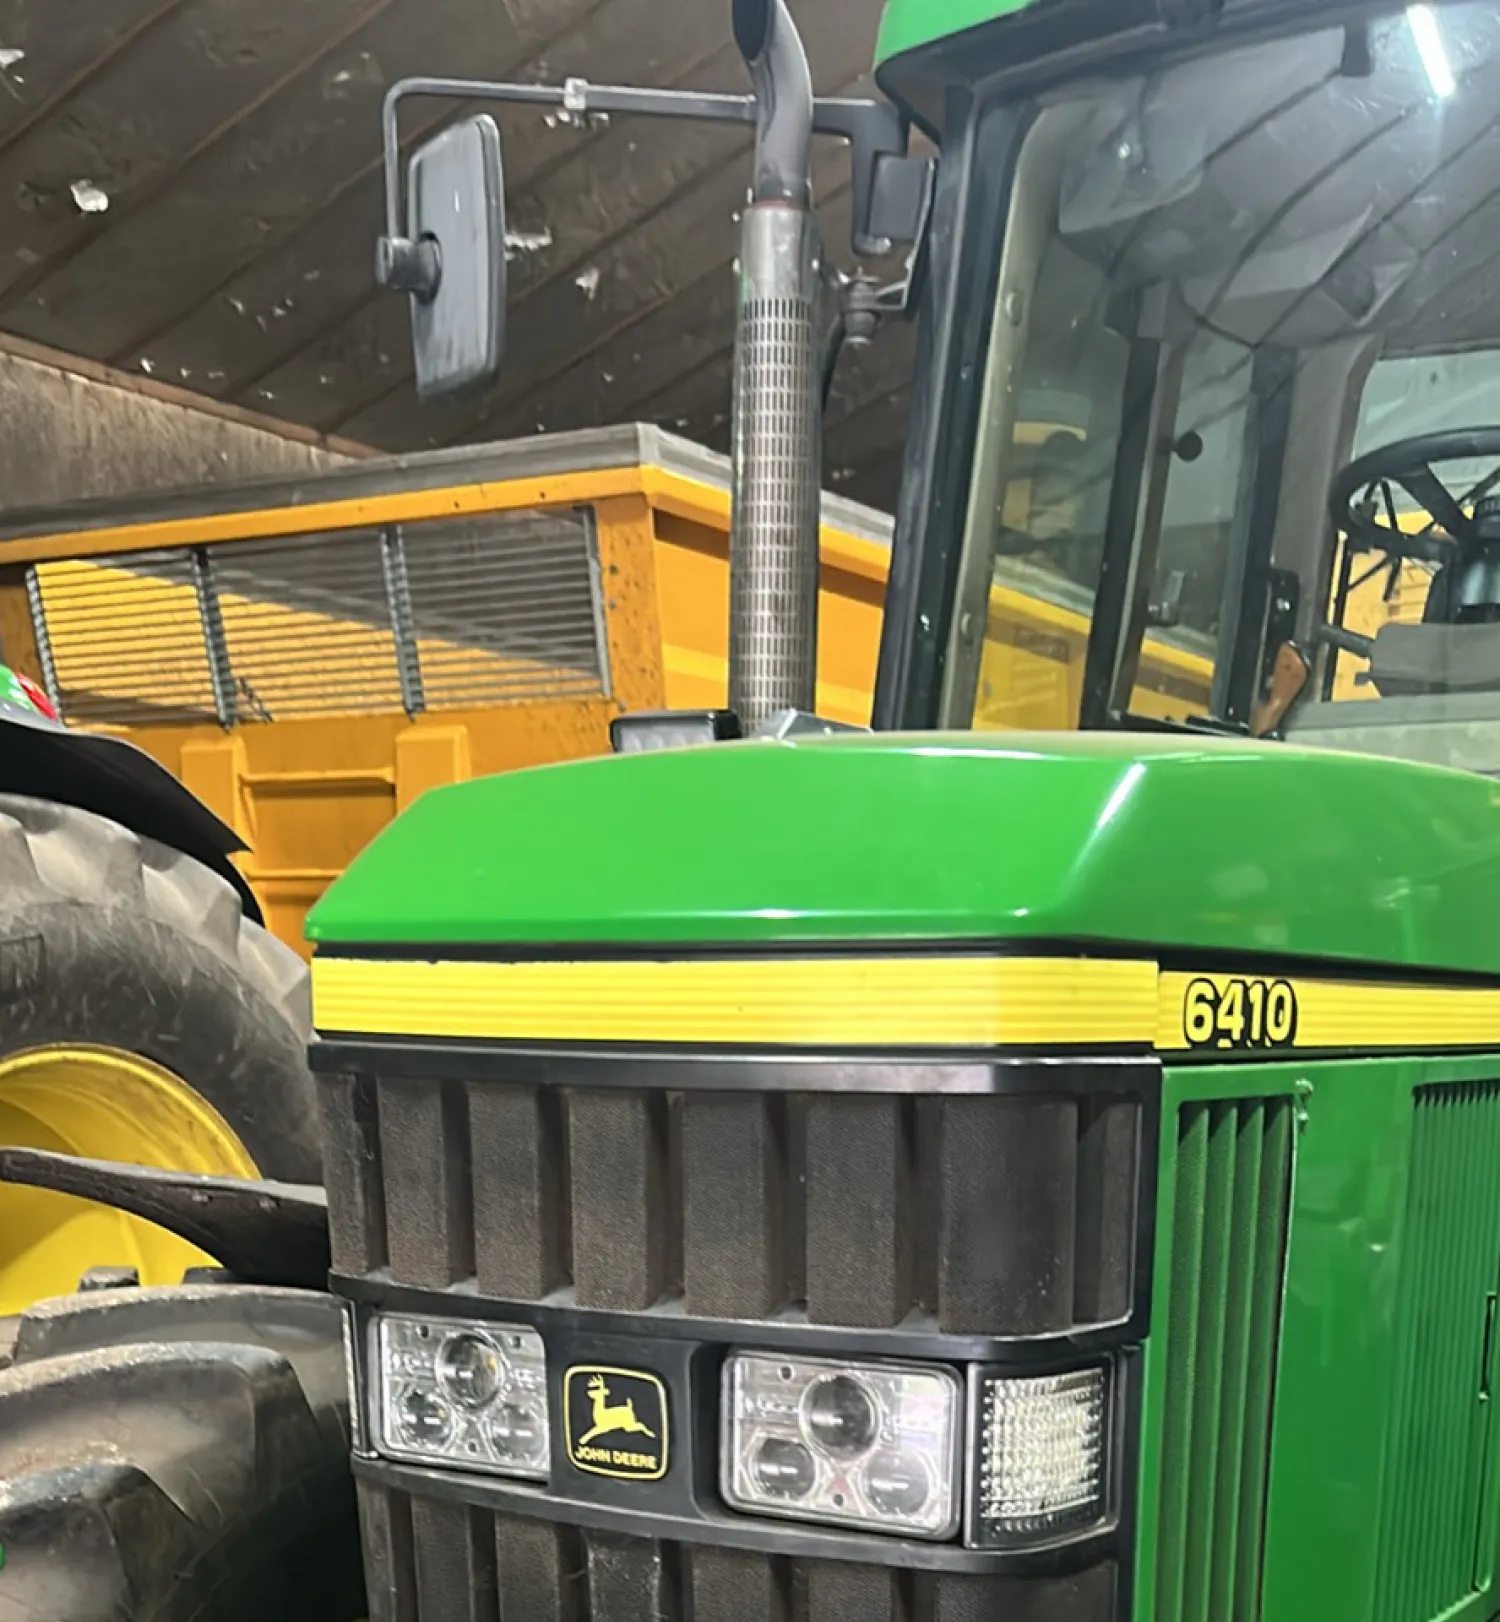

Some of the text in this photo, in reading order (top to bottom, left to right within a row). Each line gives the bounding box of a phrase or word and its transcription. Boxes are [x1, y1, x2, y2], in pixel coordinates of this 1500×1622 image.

[1184, 979, 1297, 1047] 6410
[575, 1446, 657, 1470] JOHN DEERE
